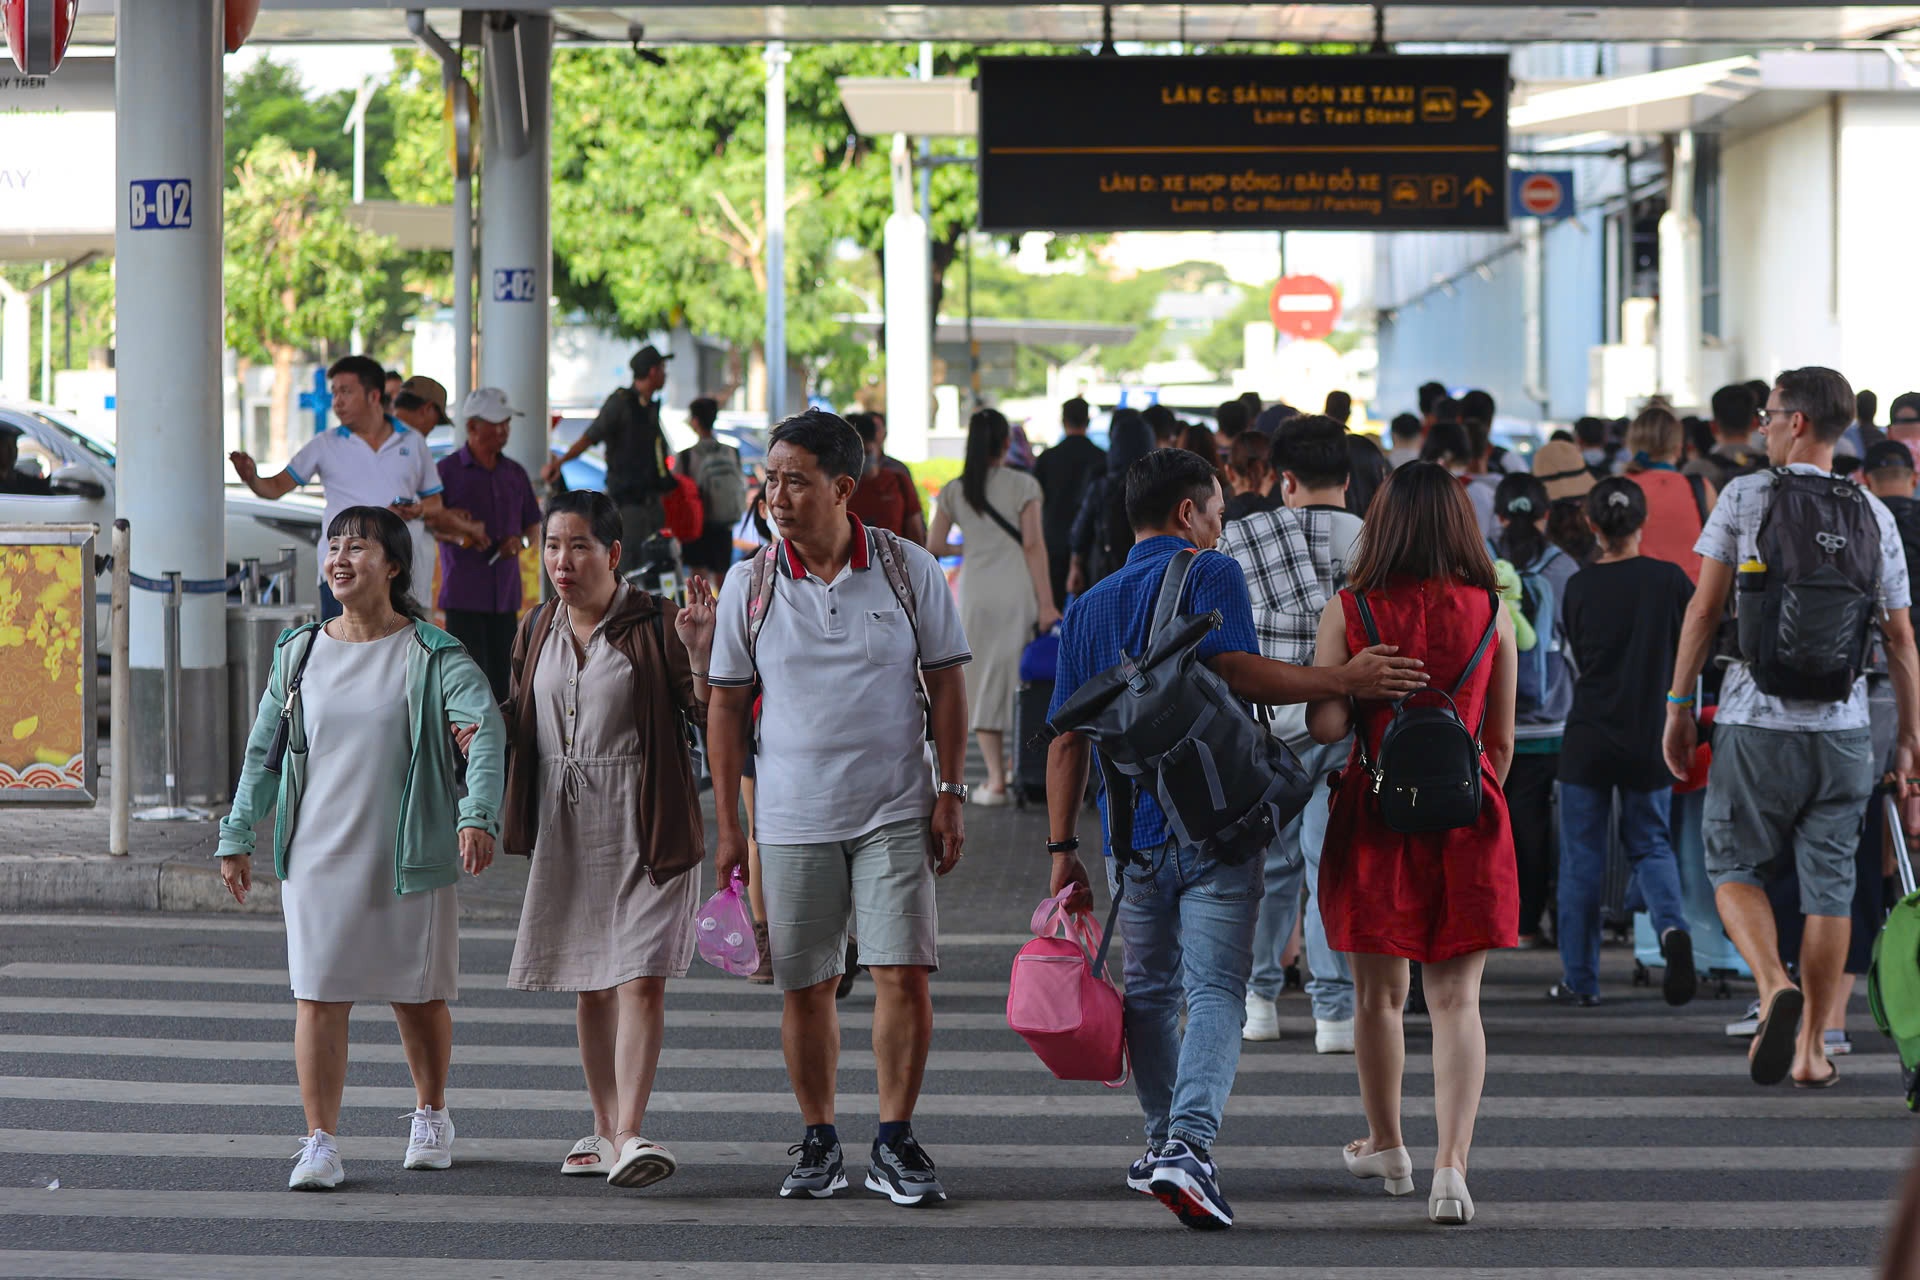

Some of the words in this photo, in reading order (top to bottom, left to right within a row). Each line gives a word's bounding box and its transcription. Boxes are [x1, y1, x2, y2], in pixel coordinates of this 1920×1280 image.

[1206, 86, 1227, 104] C:
[1340, 86, 1365, 103] XE
[1371, 86, 1415, 103] TAXI
[1253, 108, 1296, 124] Lane
[1324, 107, 1361, 124] Taxi
[1364, 107, 1415, 124] Stand
[1162, 175, 1186, 192] XE
[1358, 174, 1381, 191] XE
[131, 183, 190, 227] B-02
[1232, 196, 1259, 212] Car
[1324, 195, 1382, 215] Parking
[495, 272, 534, 299] C-02
